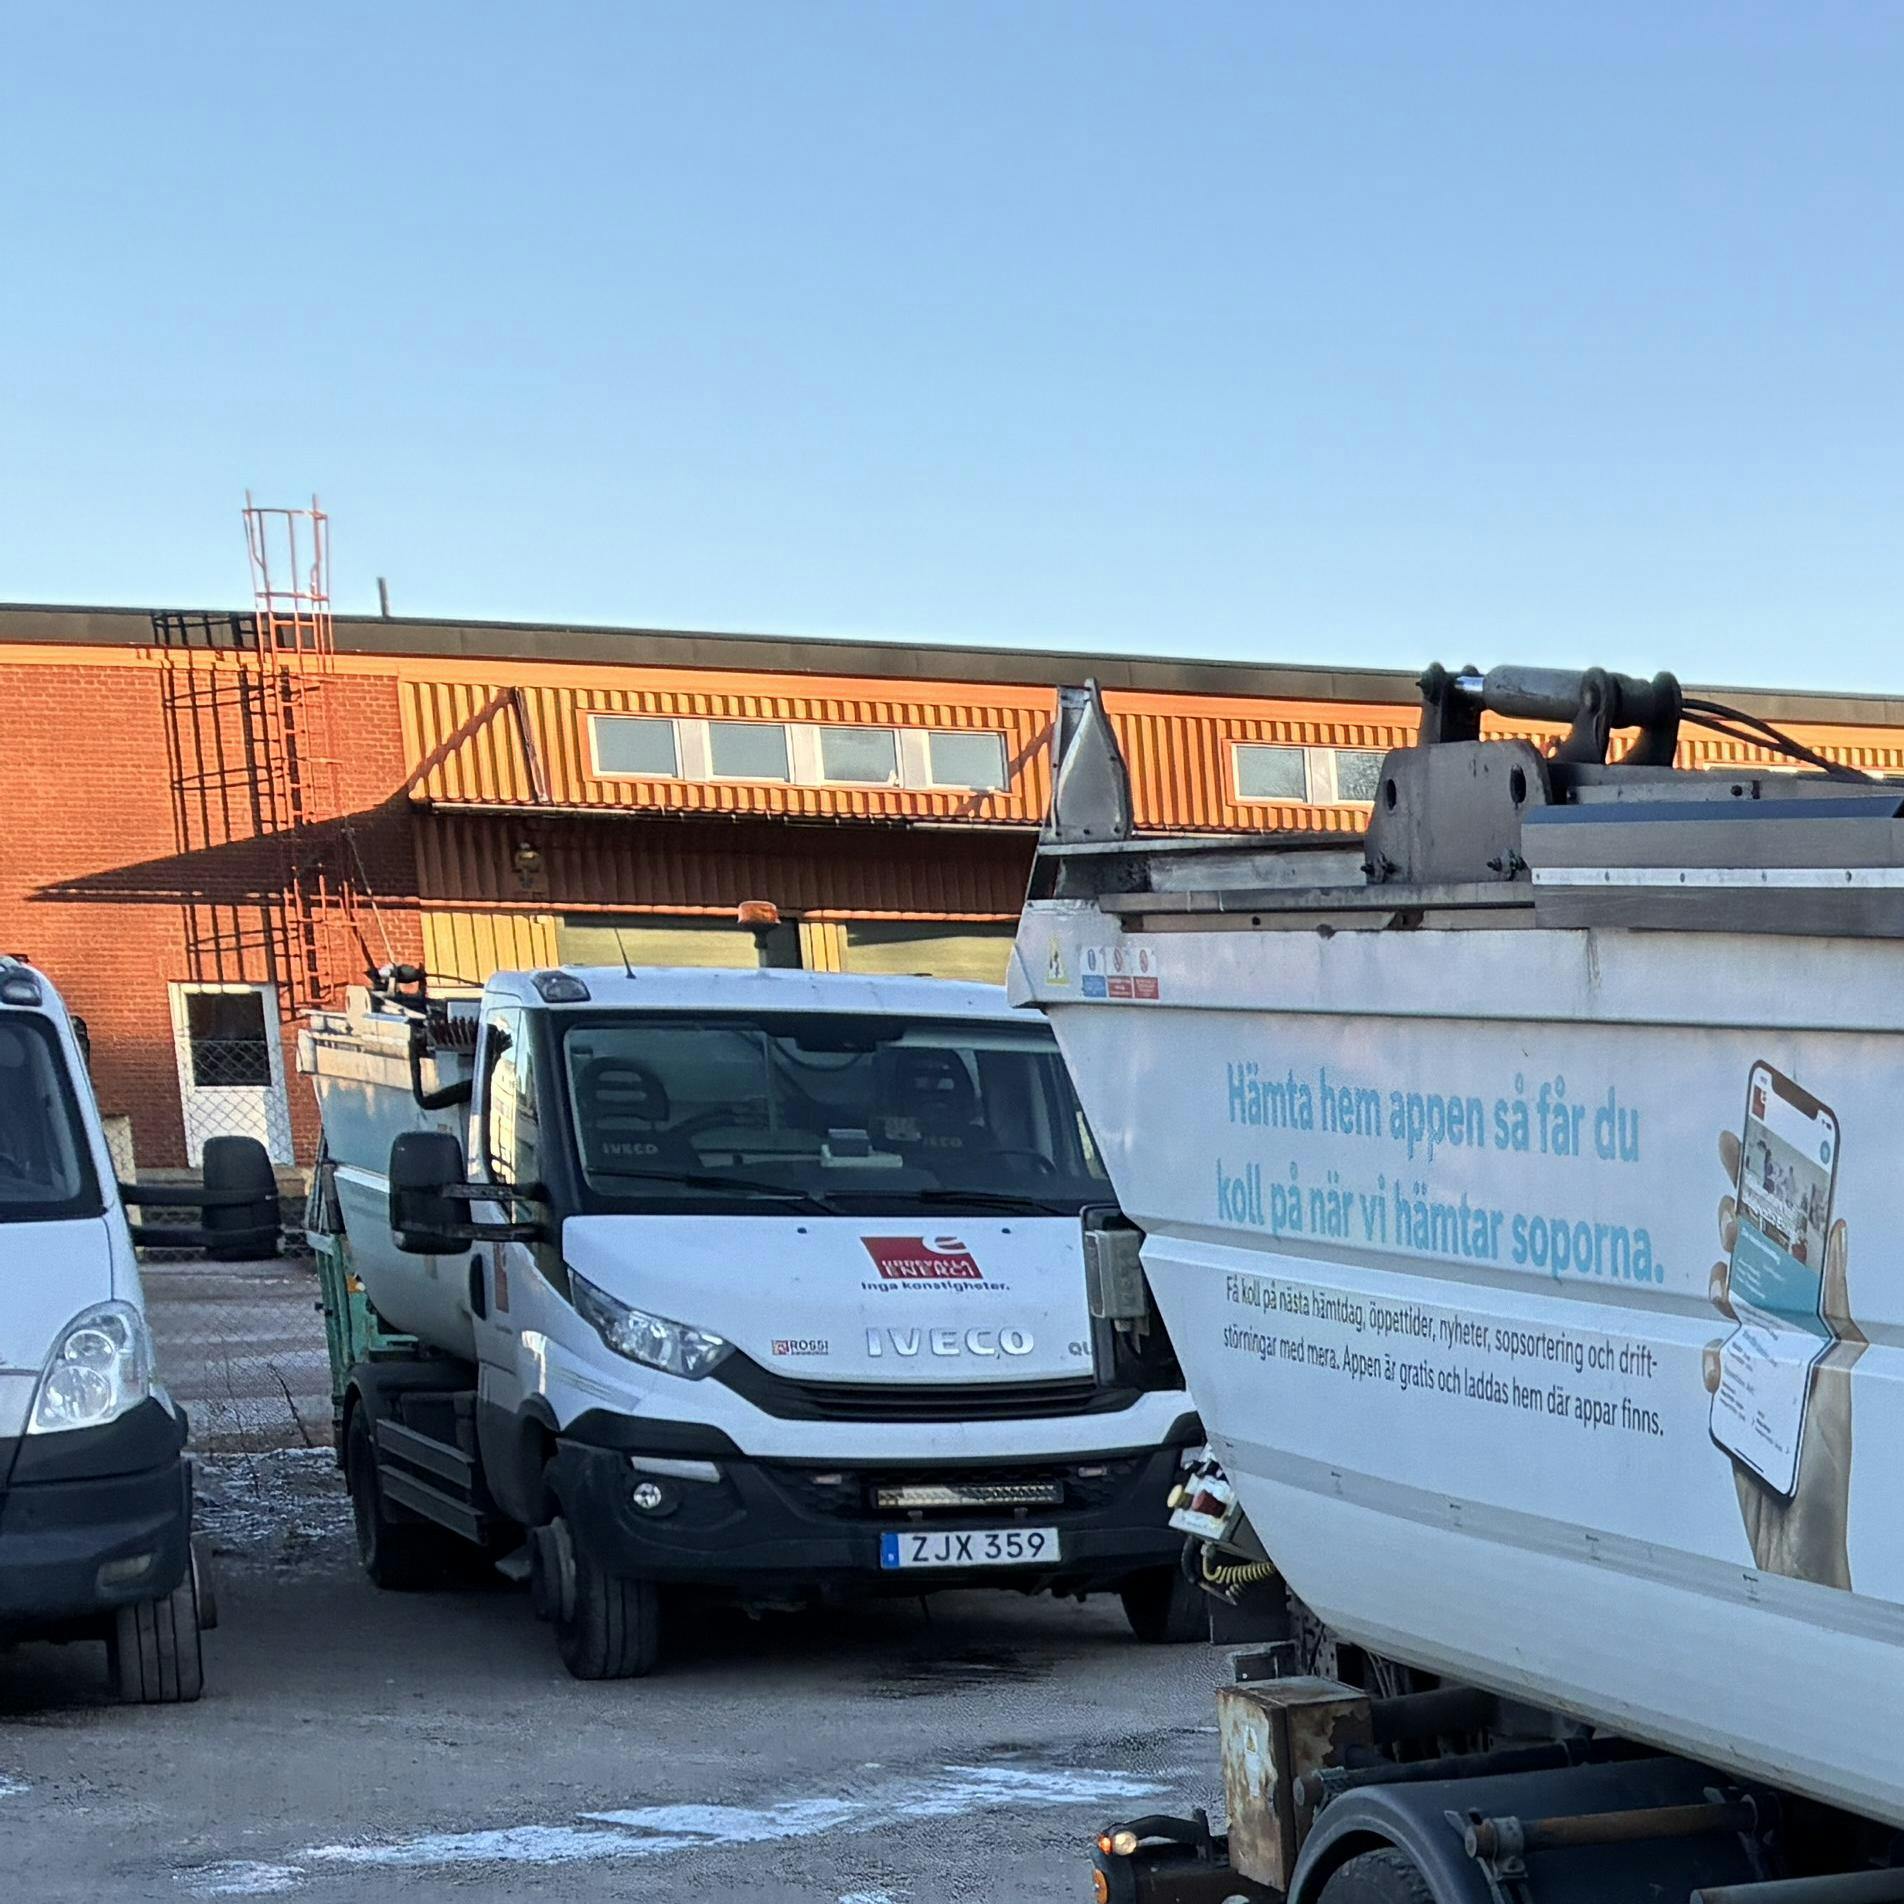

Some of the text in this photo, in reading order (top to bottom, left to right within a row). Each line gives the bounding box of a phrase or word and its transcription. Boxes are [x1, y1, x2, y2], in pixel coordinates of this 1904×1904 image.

[1227, 1060, 1640, 1163] Hämta hem appen så får du
[1216, 1158, 1264, 1226] koll
[1270, 1161, 1303, 1242] på
[1309, 1169, 1354, 1238] när
[1359, 1172, 1387, 1246] vi
[1395, 1178, 1504, 1260] hämtar
[1512, 1213, 1665, 1284] soporna.
[861, 1280, 1011, 1292] Inga konstigheter.
[1226, 1274, 1659, 1379] Få koll på nästa hämtdag, öppettider, nyheter, sopsortering och drift-
[865, 1326, 1035, 1357] IVECO
[1223, 1323, 1664, 1437] störningar med mera. Appen är gratis och laddas hem där appar finns.
[911, 1532, 1045, 1563] ZJX 359
